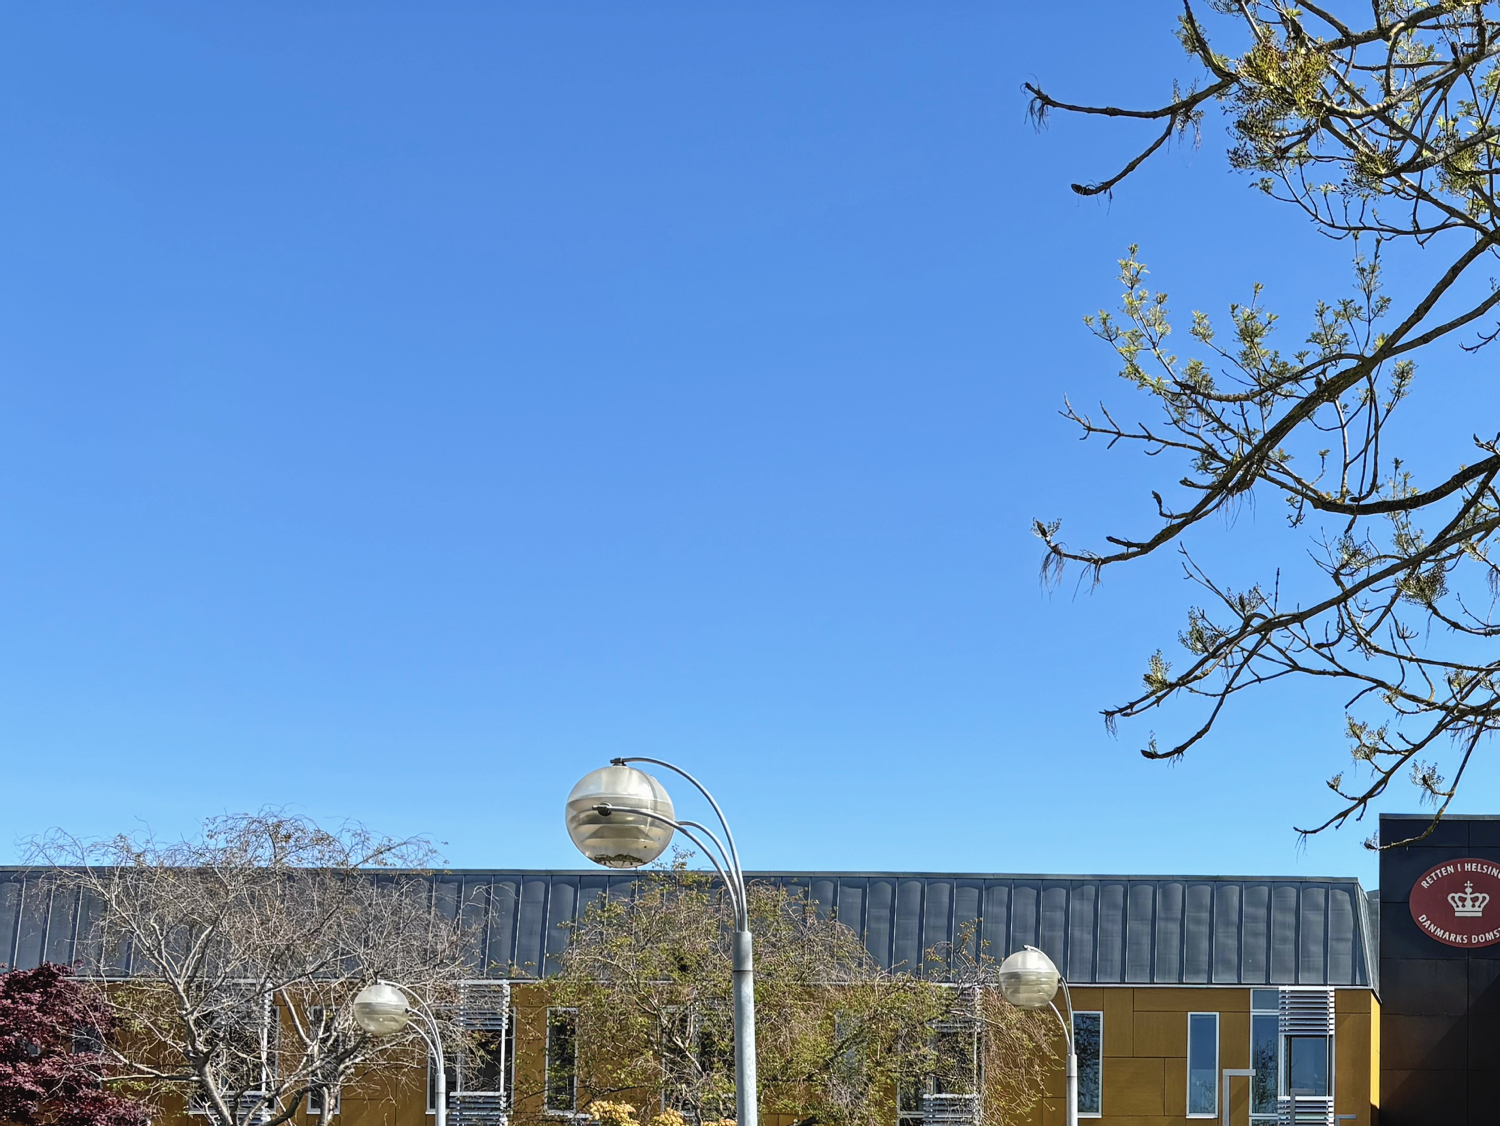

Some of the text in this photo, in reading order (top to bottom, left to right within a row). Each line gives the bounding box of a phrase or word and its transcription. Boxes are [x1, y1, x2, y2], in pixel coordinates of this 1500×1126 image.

[1421, 865, 1454, 889] RETTEN
[1458, 864, 1461, 872] I
[1418, 914, 1468, 944] DANMARKS
